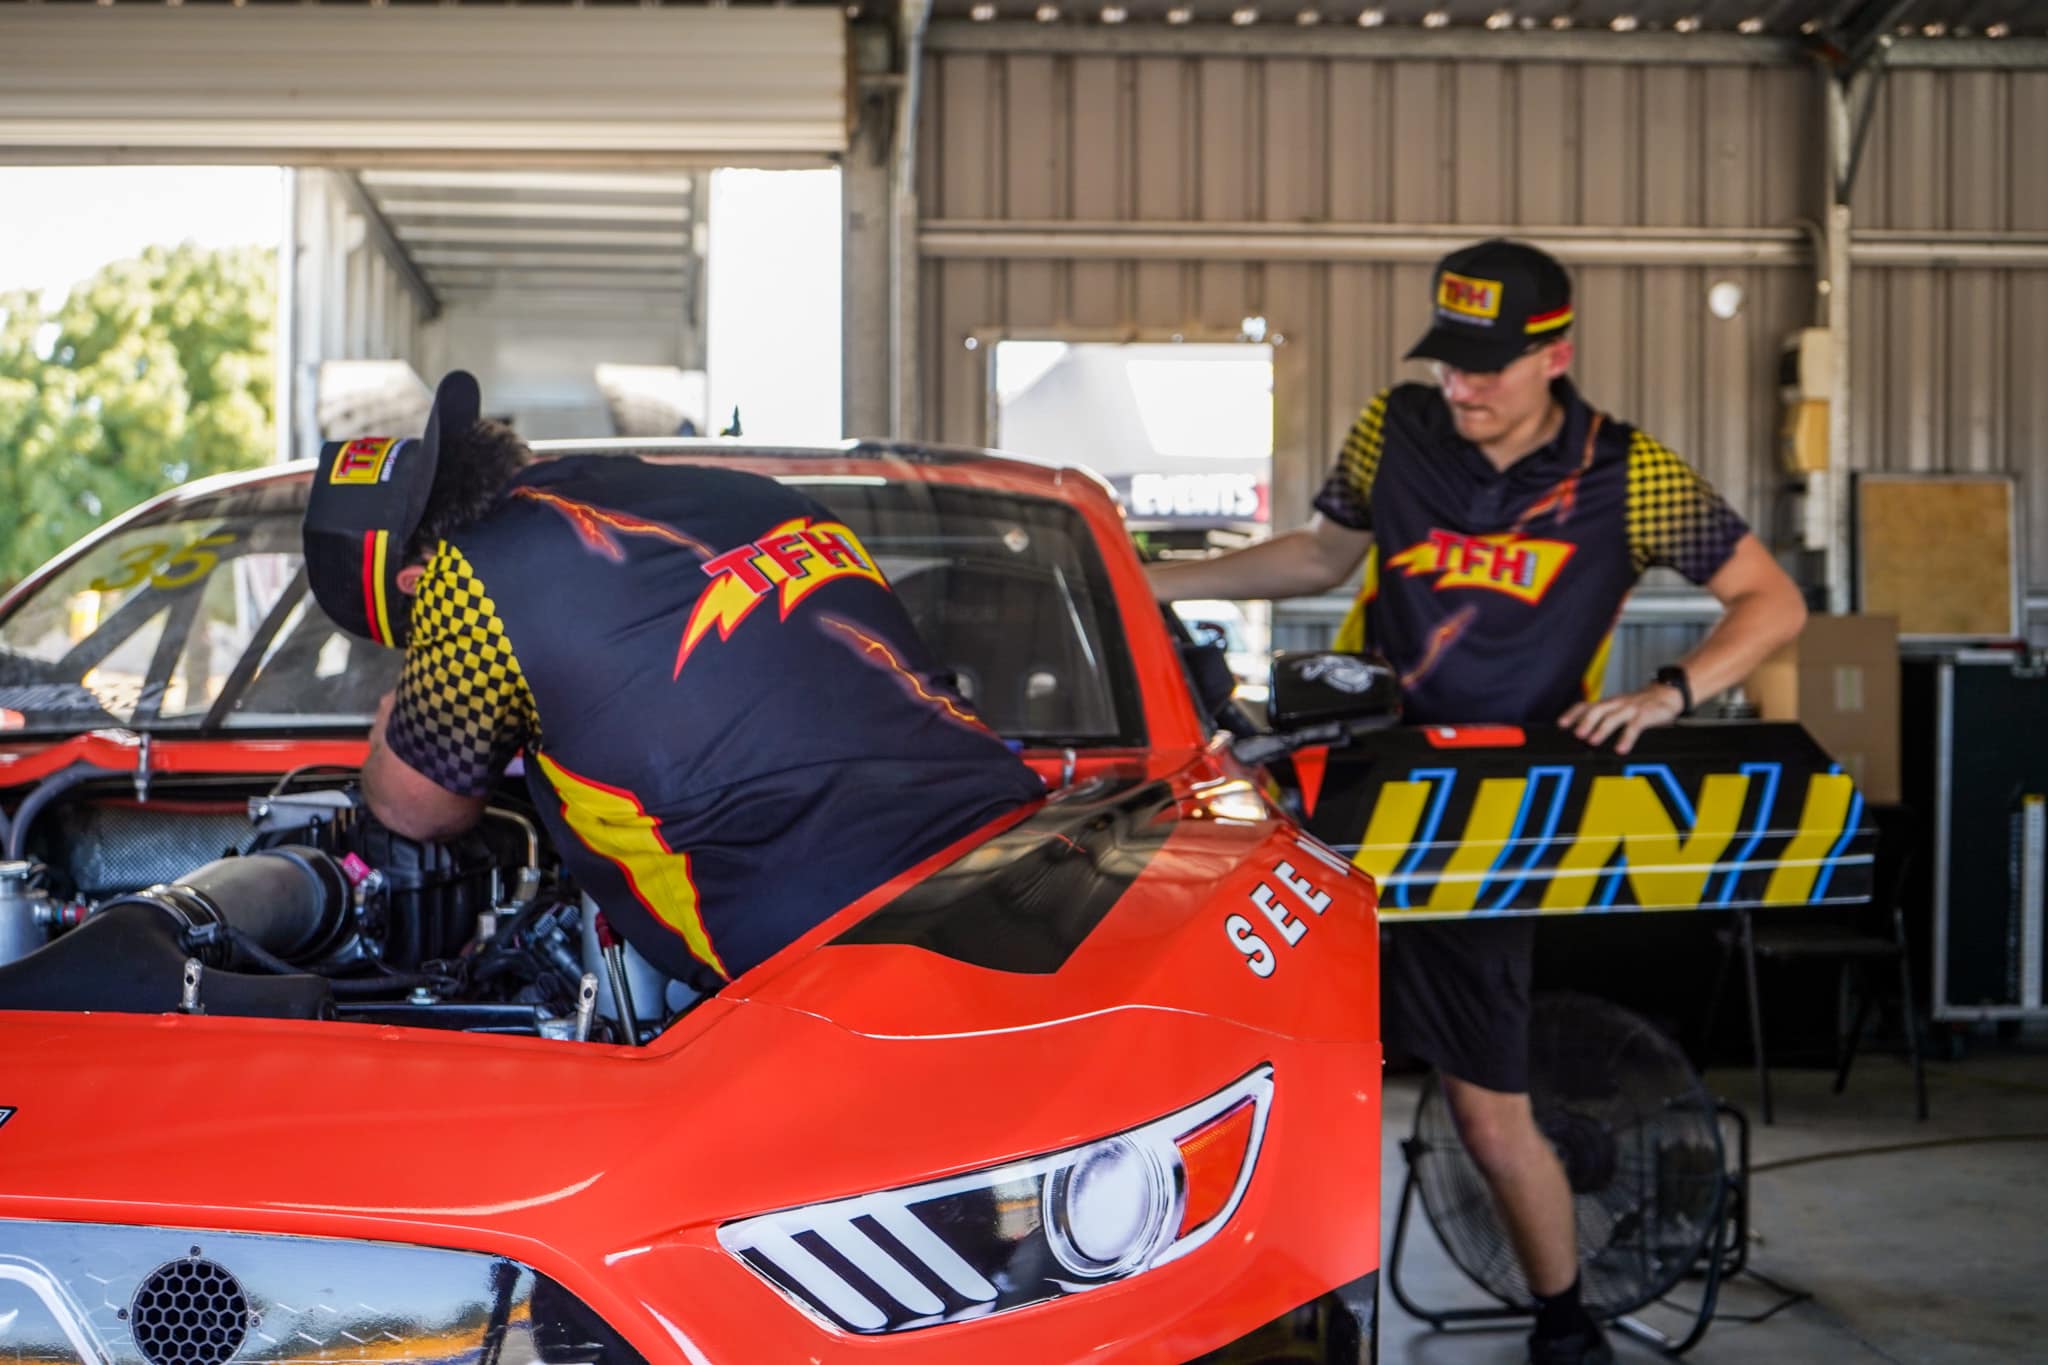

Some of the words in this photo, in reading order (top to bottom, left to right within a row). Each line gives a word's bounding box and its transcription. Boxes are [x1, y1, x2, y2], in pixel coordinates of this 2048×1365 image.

[1444, 279, 1489, 308] TFH
[90, 534, 238, 592] 35
[701, 530, 866, 594] TFH
[1429, 528, 1527, 586] TFH
